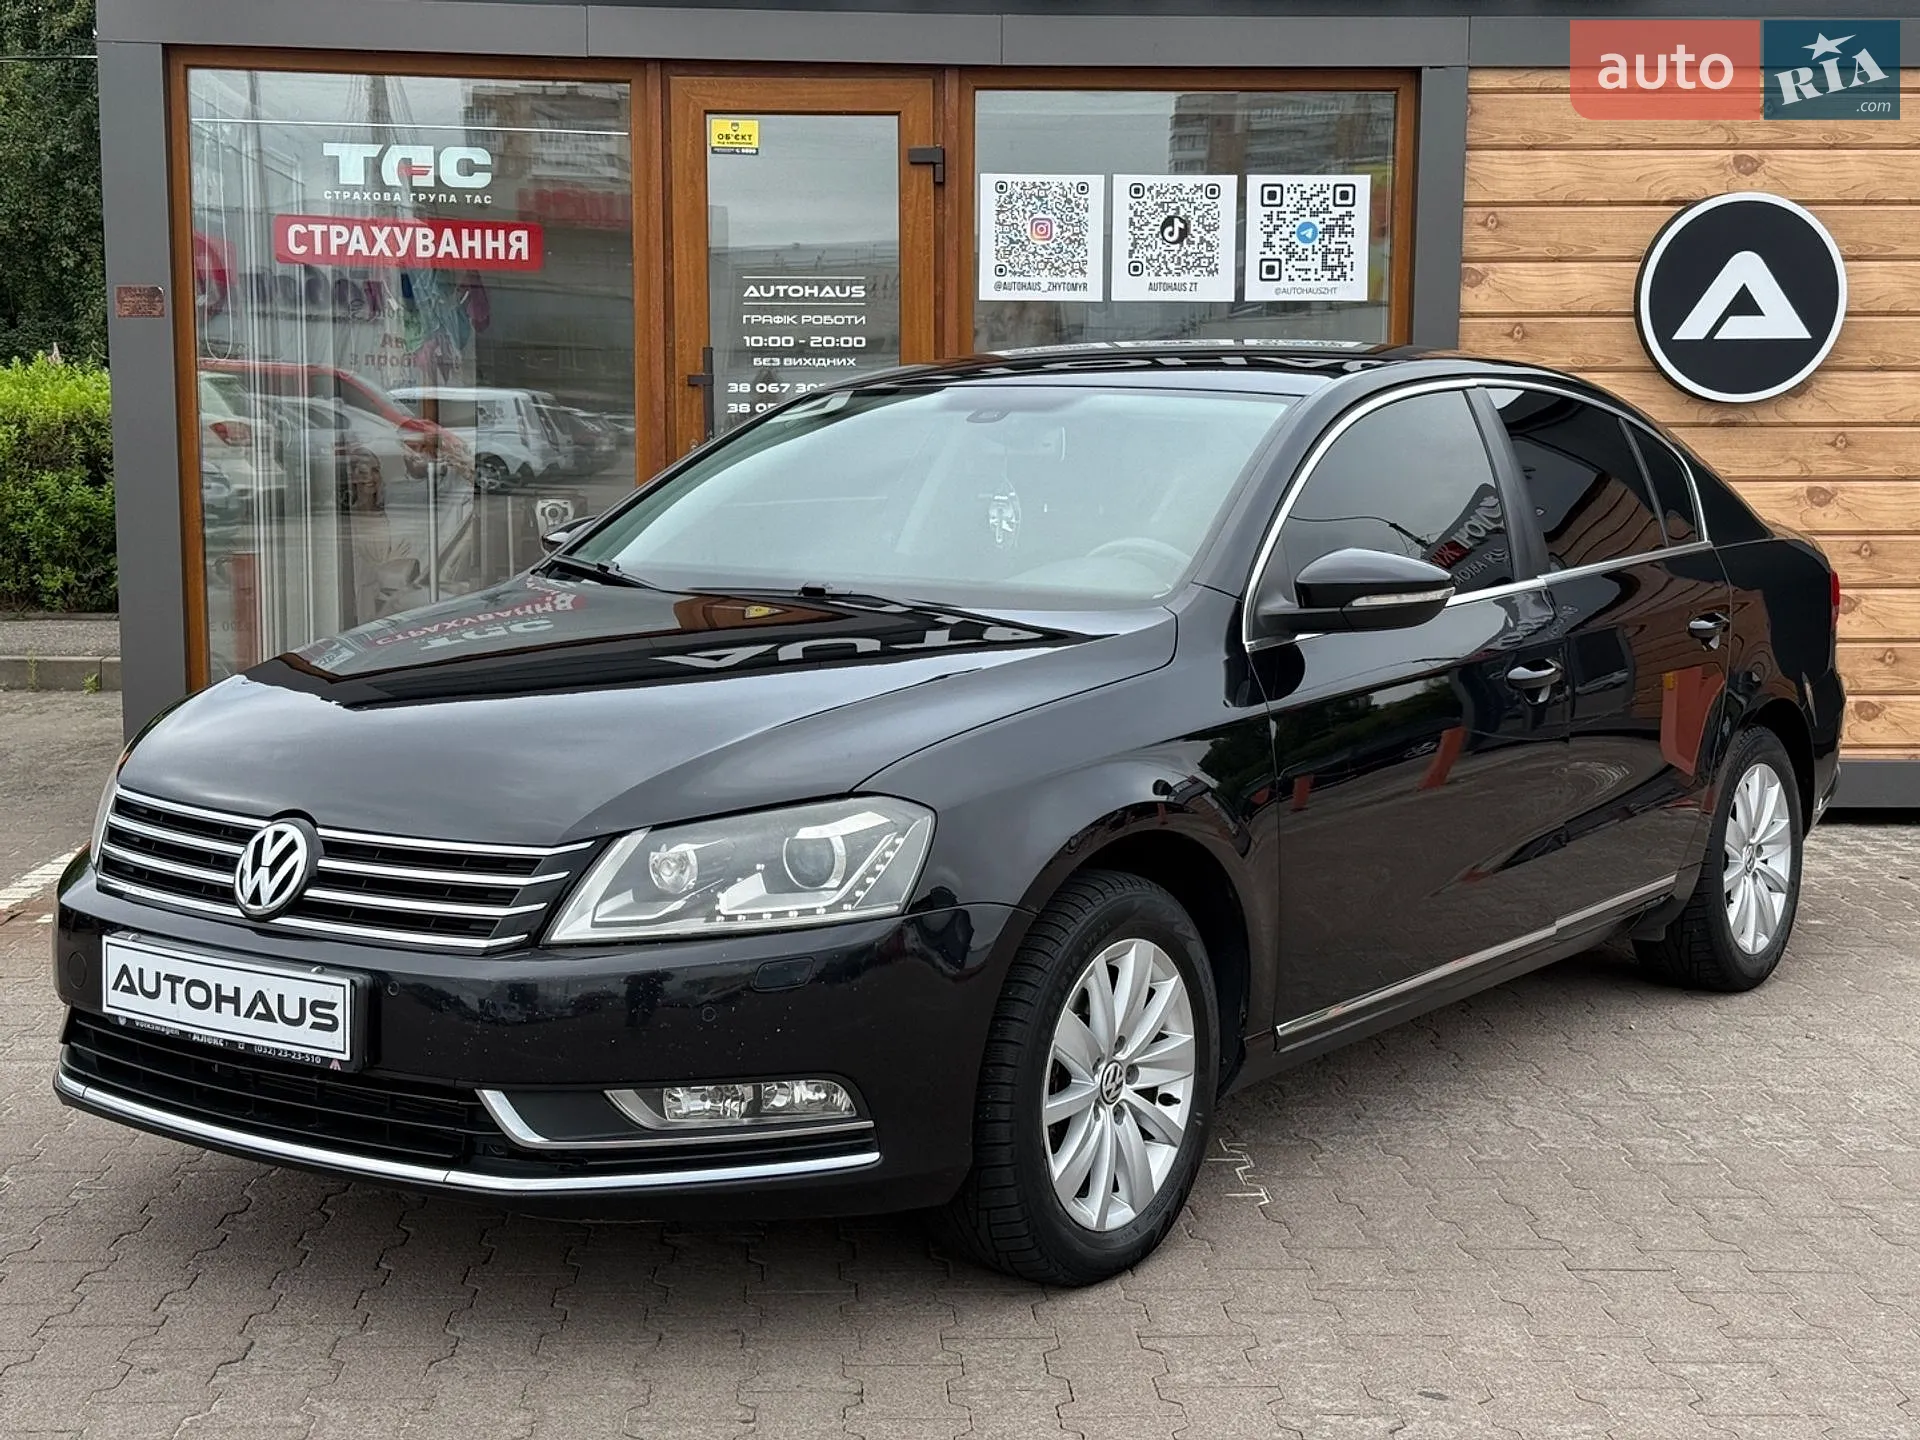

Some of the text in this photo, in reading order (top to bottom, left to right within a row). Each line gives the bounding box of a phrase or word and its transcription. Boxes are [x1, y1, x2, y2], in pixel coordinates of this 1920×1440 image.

[323, 191, 492, 204] СТРАХОВА ГРУПА ТАС
[287, 223, 530, 261] СТРАХУВАННЯ
[743, 285, 866, 298] AUTOHAUS
[993, 281, 1088, 293] @AUTOHAUS_ZHYTOMYR
[1148, 281, 1198, 292] AUTOHAUS ZT
[743, 315, 866, 325] ГРАФІК РОБОТИ
[743, 336, 794, 347] 10:00
[810, 336, 866, 347] 20:00
[753, 358, 856, 367] БЕЗ ВИХІДНИХ
[727, 383, 751, 393] 38
[755, 383, 791, 393] 067
[727, 403, 751, 413] 38
[111, 963, 340, 1033] AUTOHAUS
